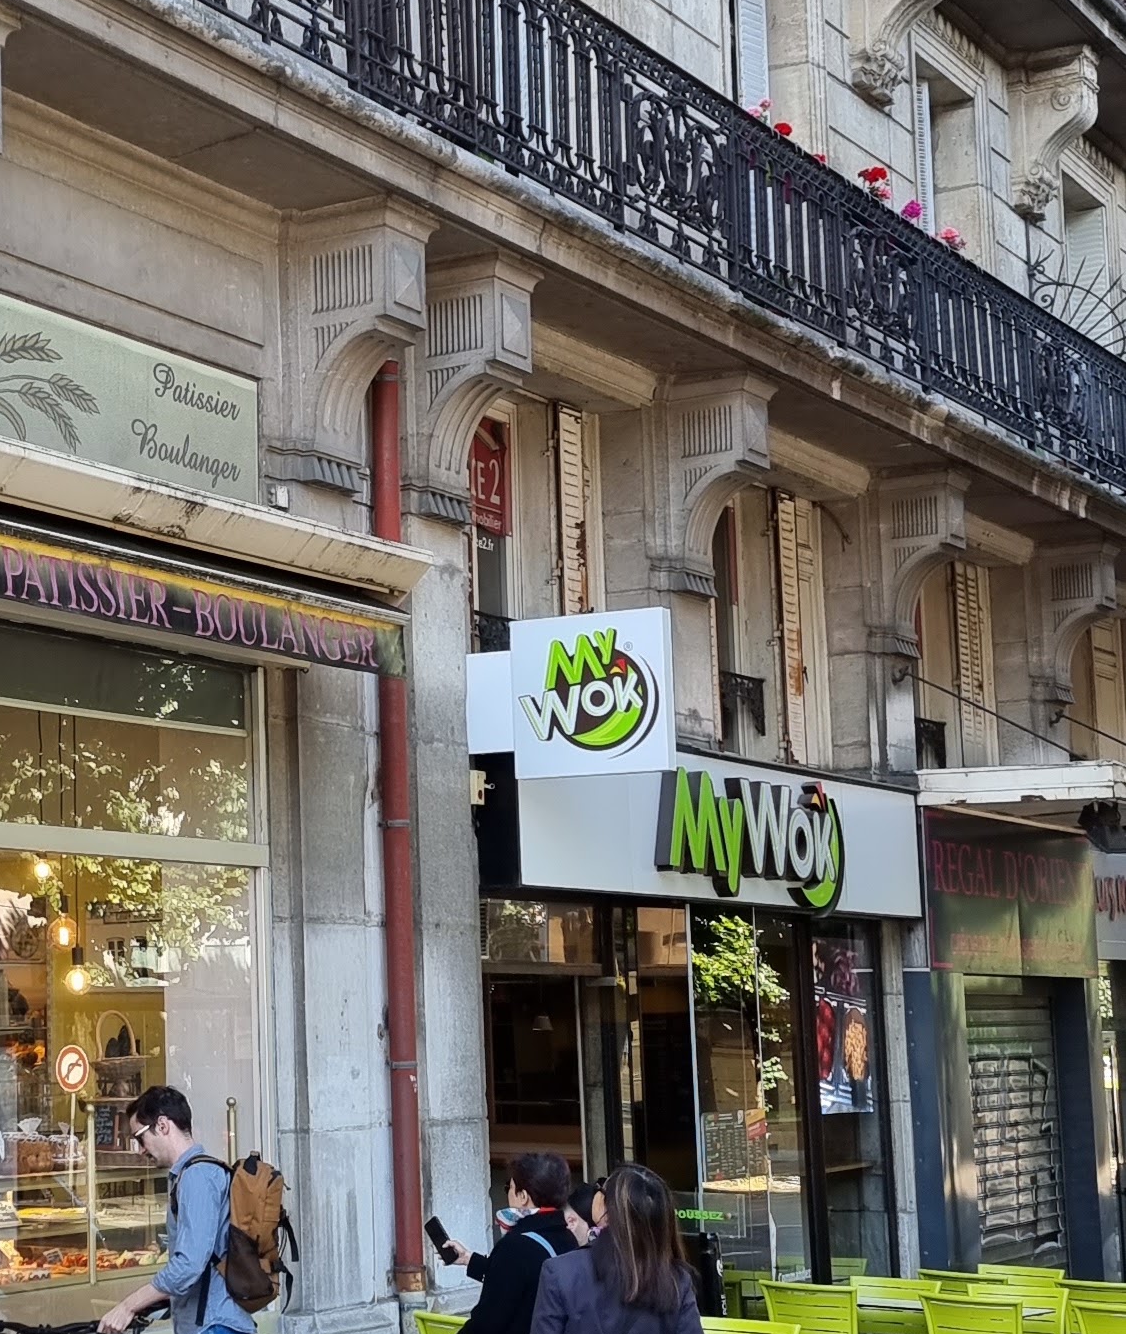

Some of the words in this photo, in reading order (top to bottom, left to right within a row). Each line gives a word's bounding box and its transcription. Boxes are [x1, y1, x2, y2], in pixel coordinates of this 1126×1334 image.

[153, 362, 241, 422] Patissier
[131, 418, 241, 489] Boulanger
[932, 840, 1001, 899] REGAL
